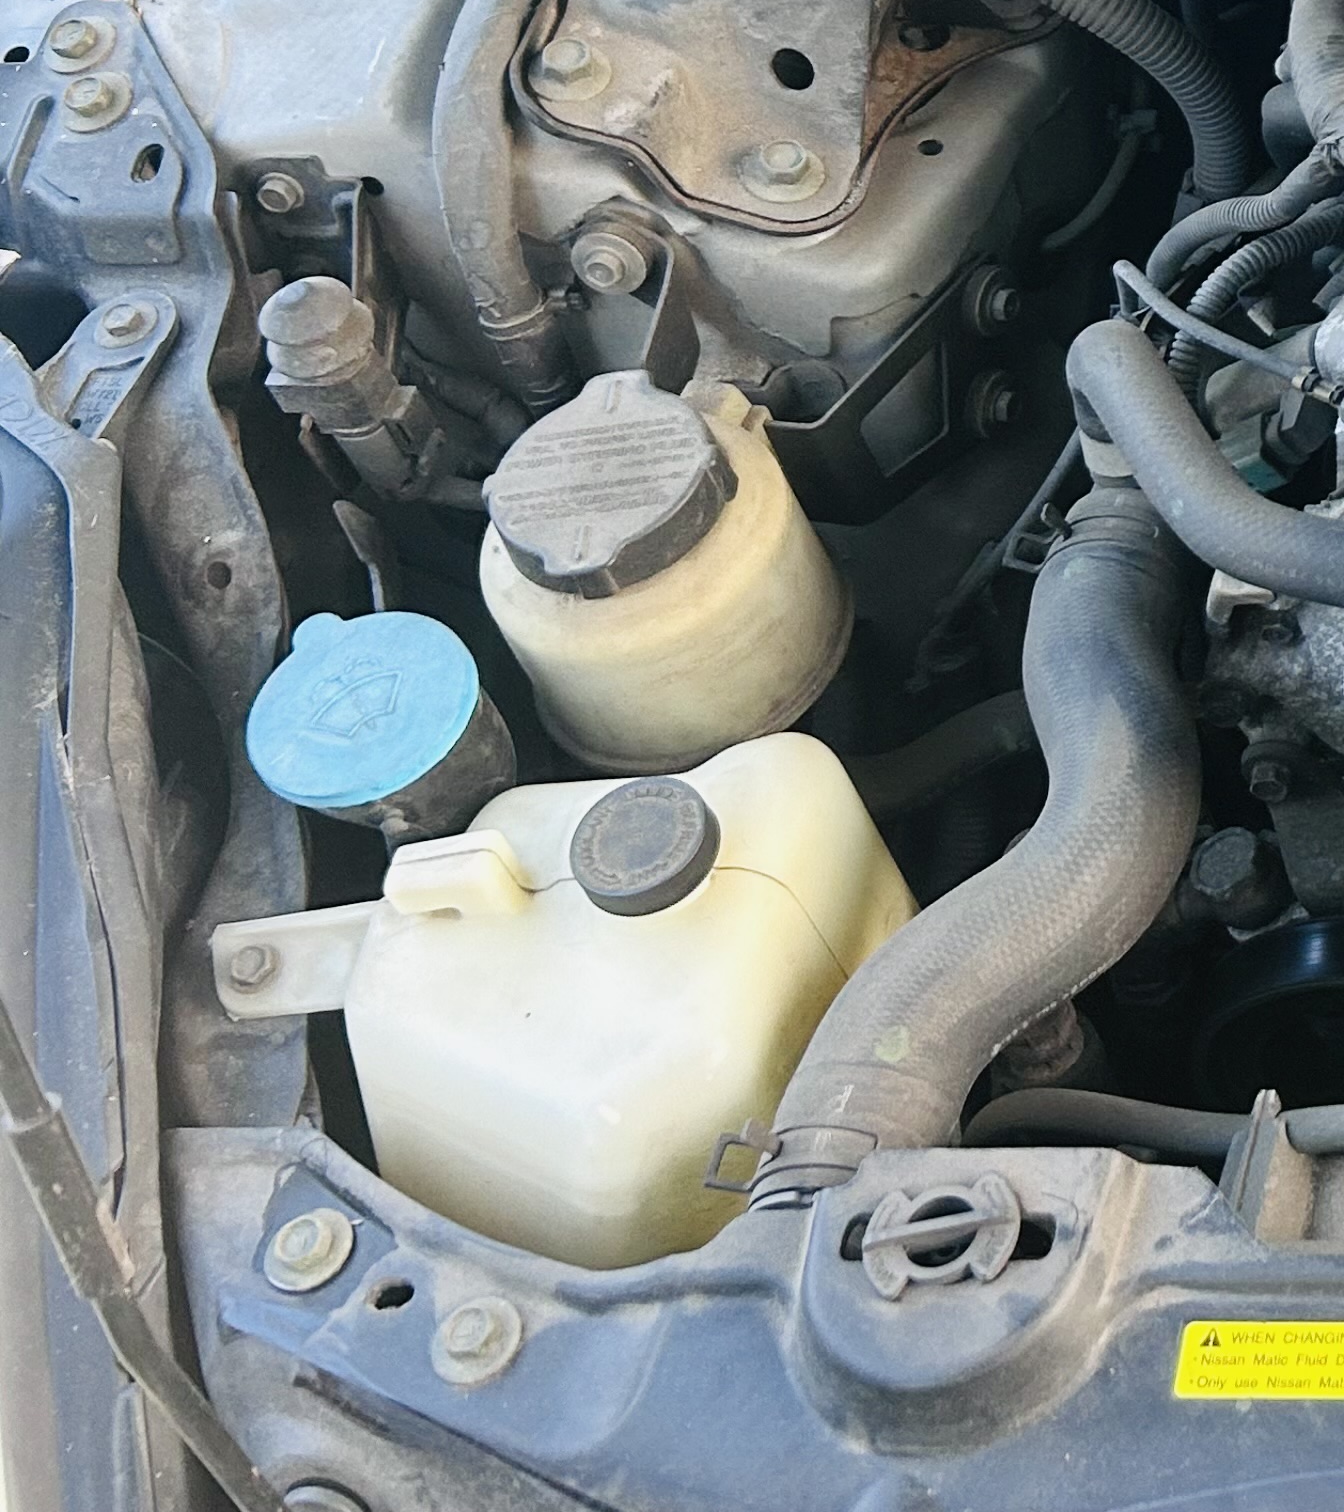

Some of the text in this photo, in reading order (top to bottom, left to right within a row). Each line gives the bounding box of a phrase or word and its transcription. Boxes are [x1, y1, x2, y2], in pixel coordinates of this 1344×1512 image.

[1232, 1332, 1276, 1345] WHEN
[1253, 1353, 1289, 1366] Matic
[1296, 1353, 1328, 1366] Fluid
[1197, 1375, 1229, 1390] Only
[1235, 1378, 1258, 1389] use
[1266, 1376, 1311, 1389] Nissan
